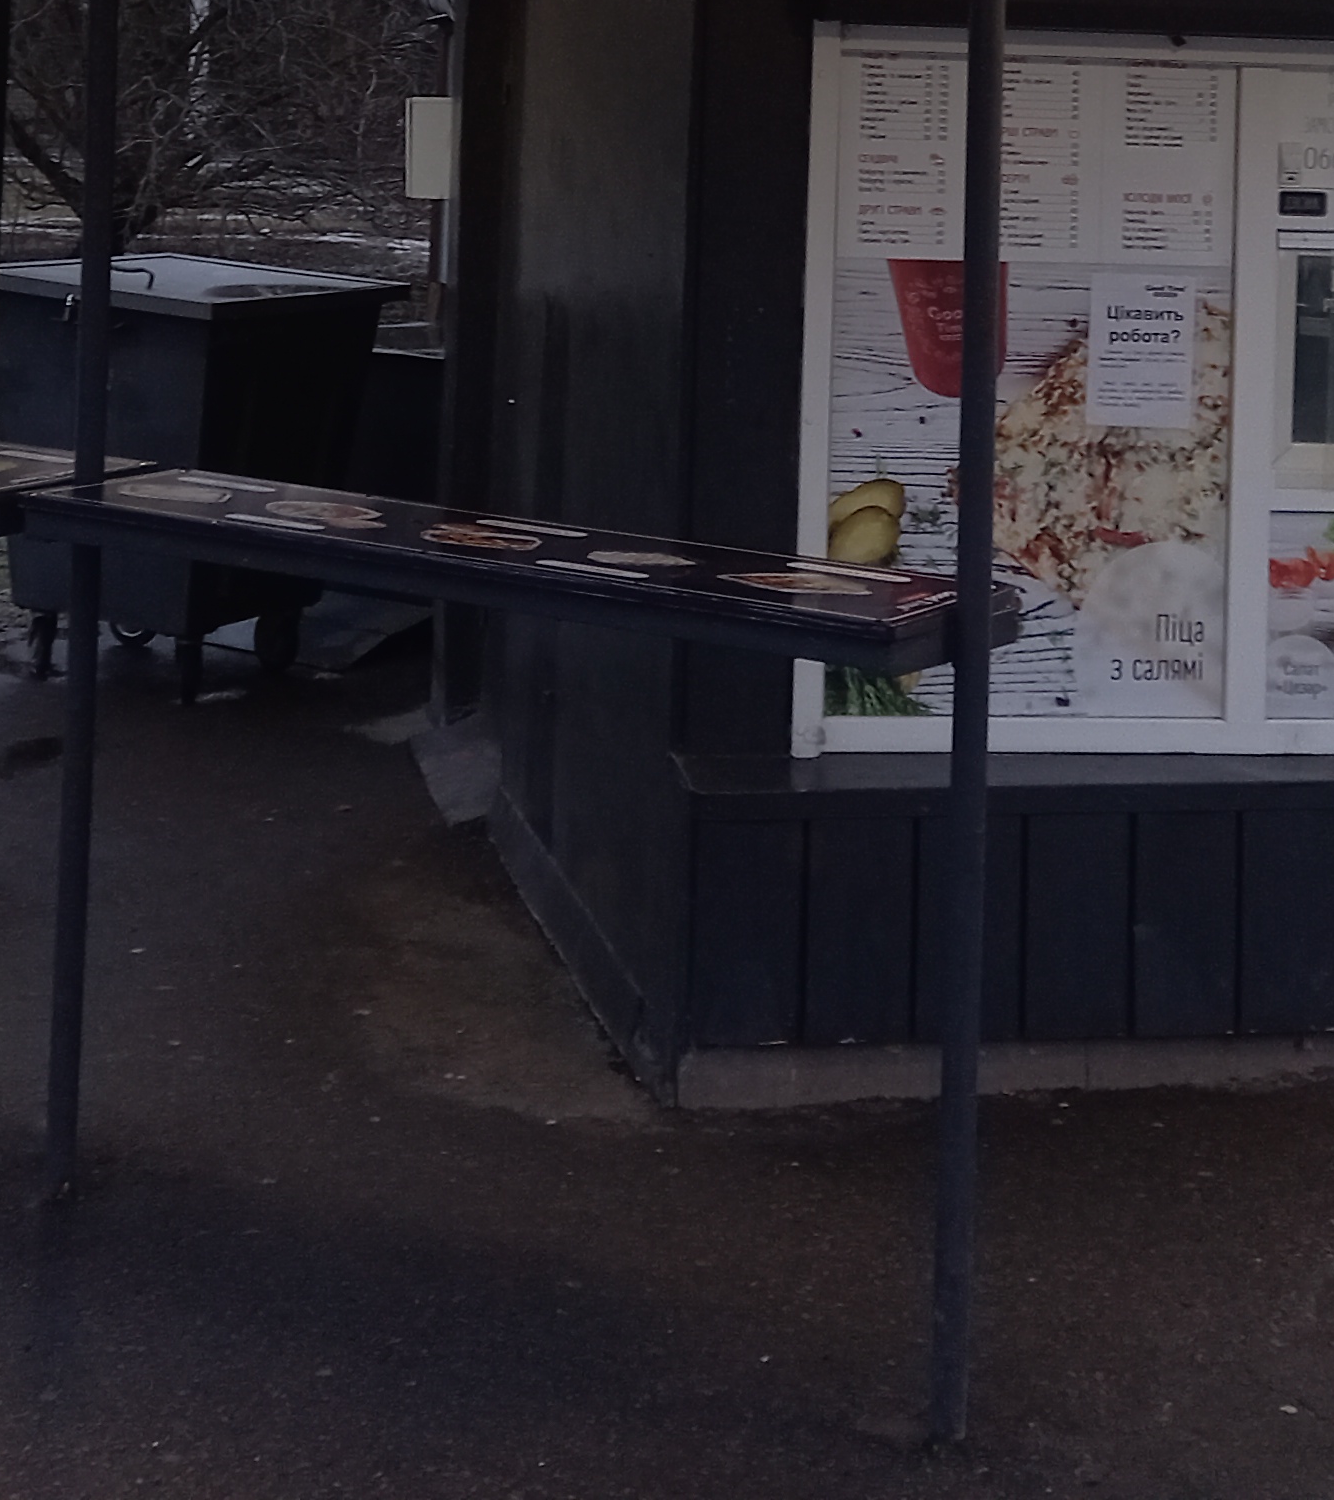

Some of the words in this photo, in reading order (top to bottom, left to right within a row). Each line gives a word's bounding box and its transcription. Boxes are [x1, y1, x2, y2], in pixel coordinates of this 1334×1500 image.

[927, 306, 964, 321] Goo
[1107, 304, 1185, 323] Цікавить
[1109, 328, 1182, 345] робота?
[1155, 613, 1205, 647] Піца
[1110, 659, 1123, 681] з
[1131, 652, 1204, 681] салямі
